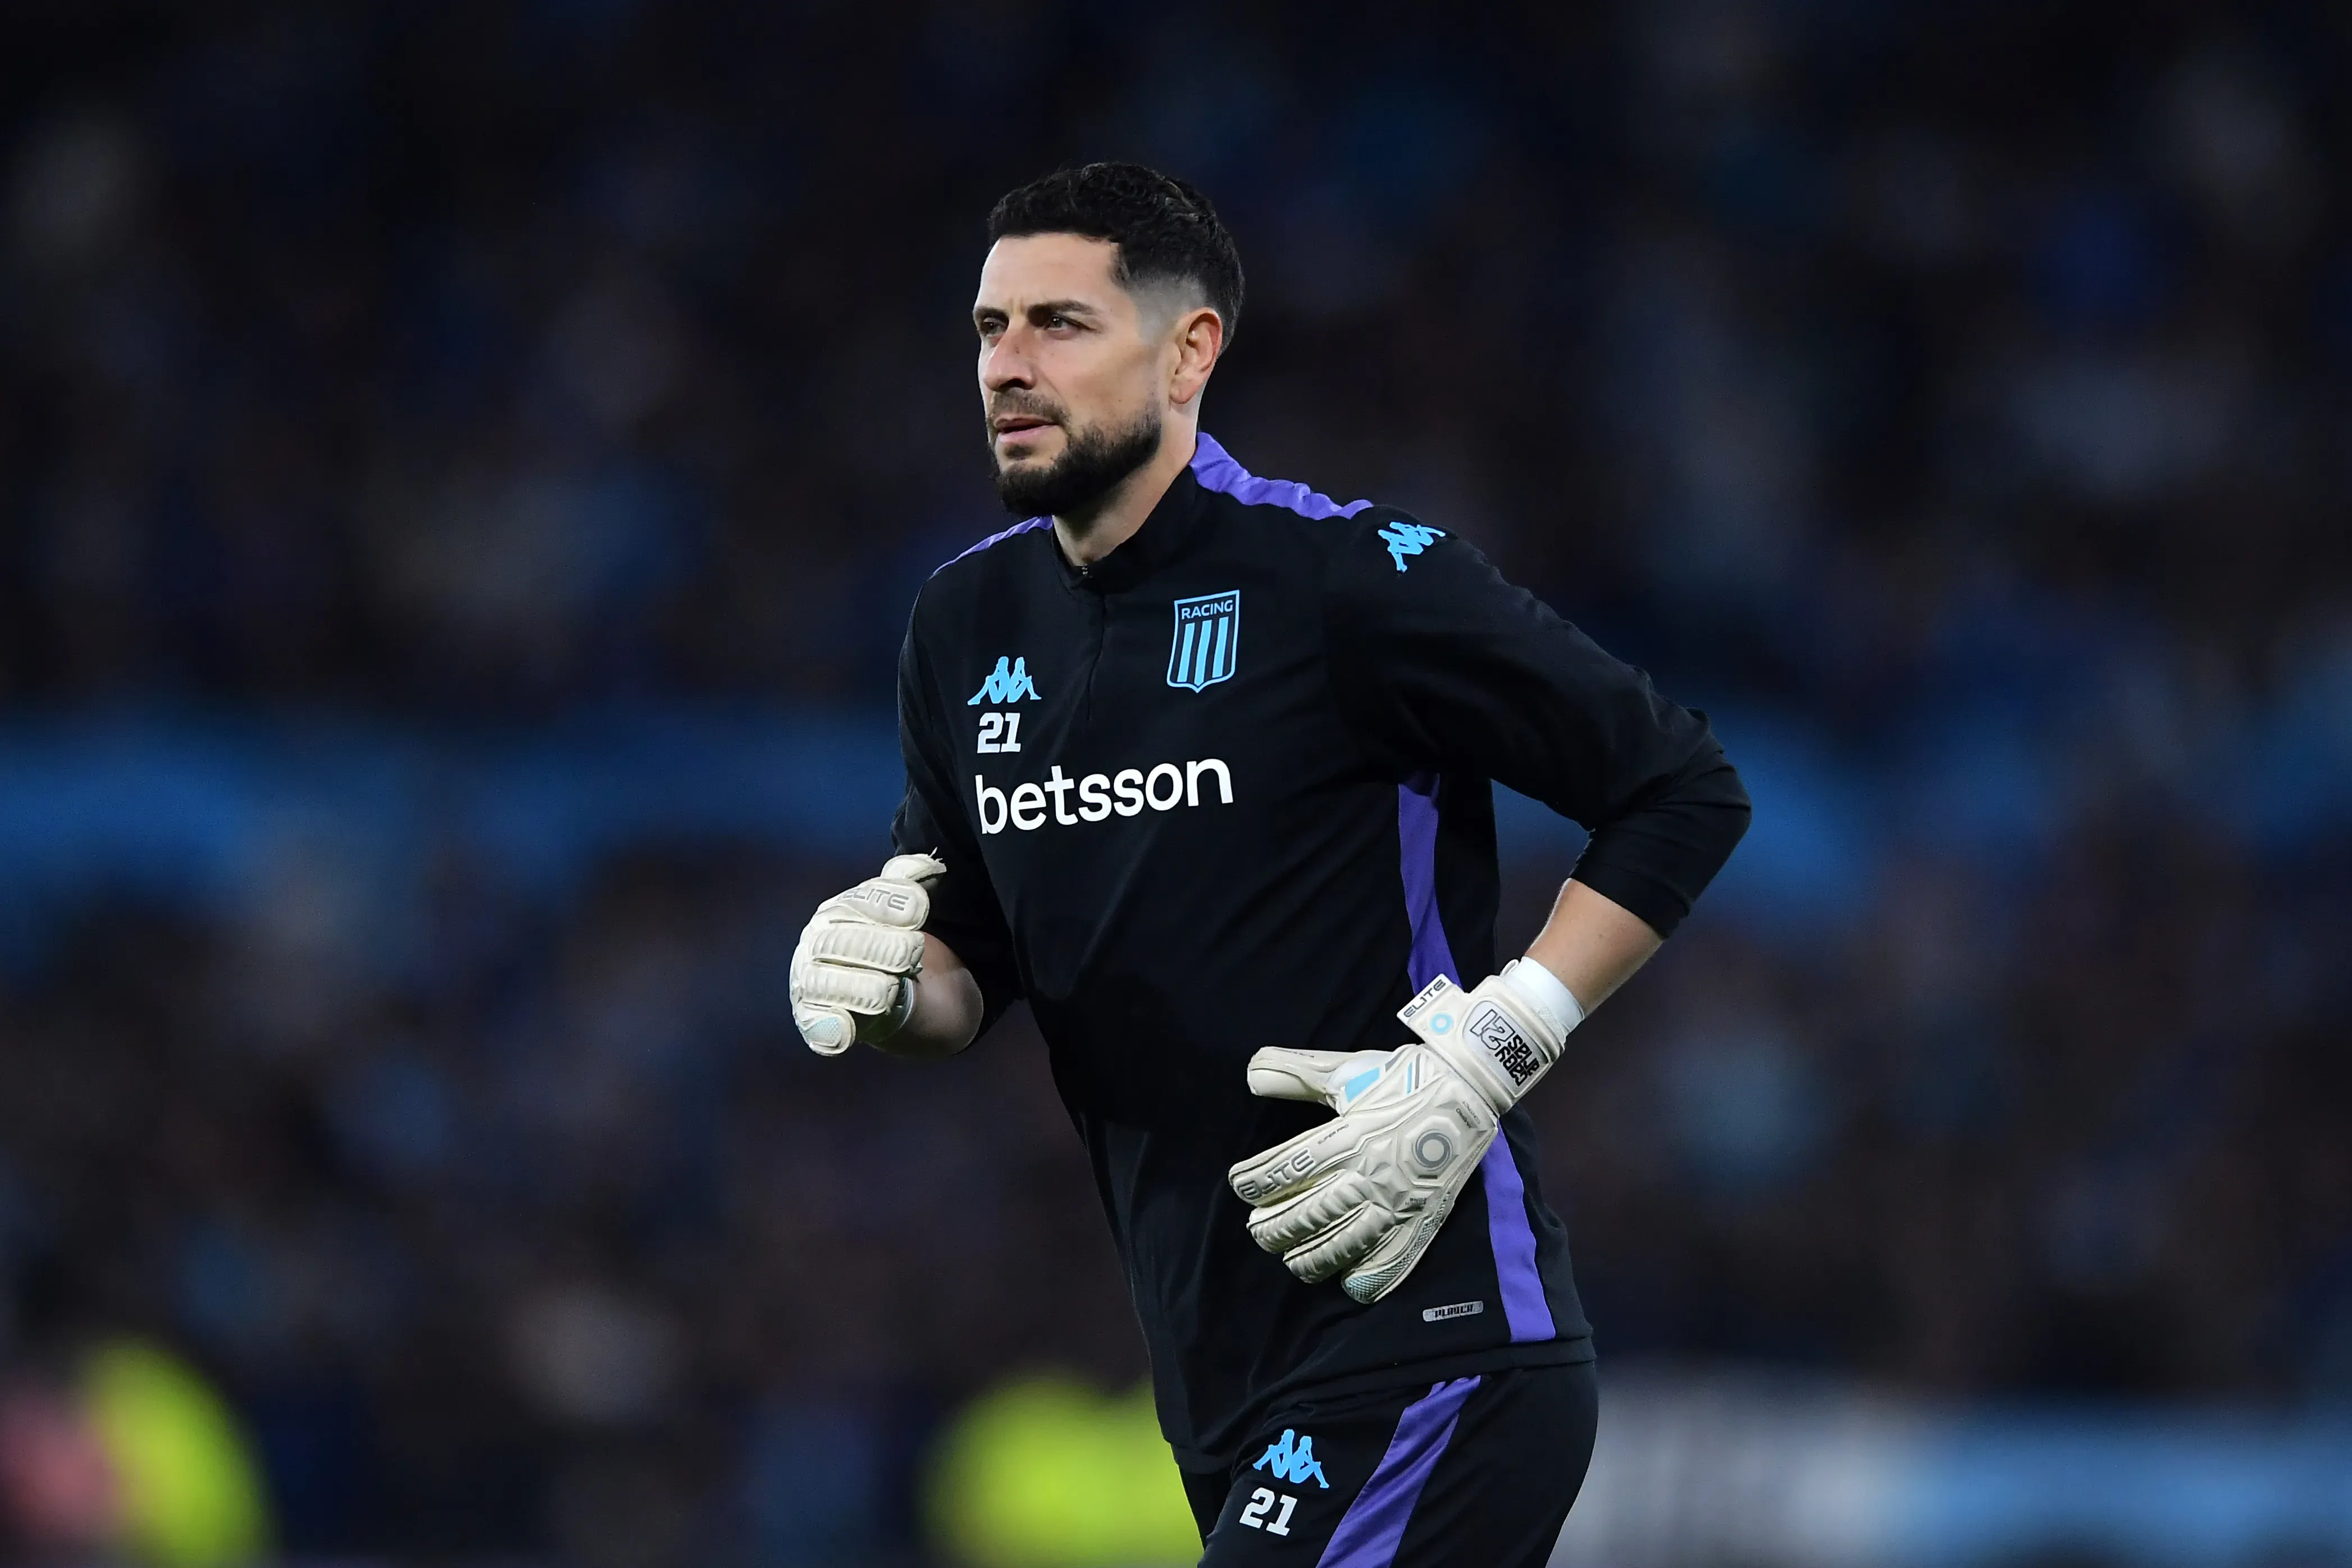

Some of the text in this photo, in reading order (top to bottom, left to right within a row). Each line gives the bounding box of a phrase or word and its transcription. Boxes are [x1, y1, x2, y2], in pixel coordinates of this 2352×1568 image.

[1181, 600, 1233, 619] RACING
[977, 712, 1022, 754] 21
[975, 758, 1233, 835] betsson
[842, 887, 910, 911] ELITE
[1403, 979, 1446, 1018] ELITE
[1469, 1009, 1516, 1050] 21
[1236, 1147, 1315, 1201] ELITE
[1239, 1487, 1298, 1536] 21
